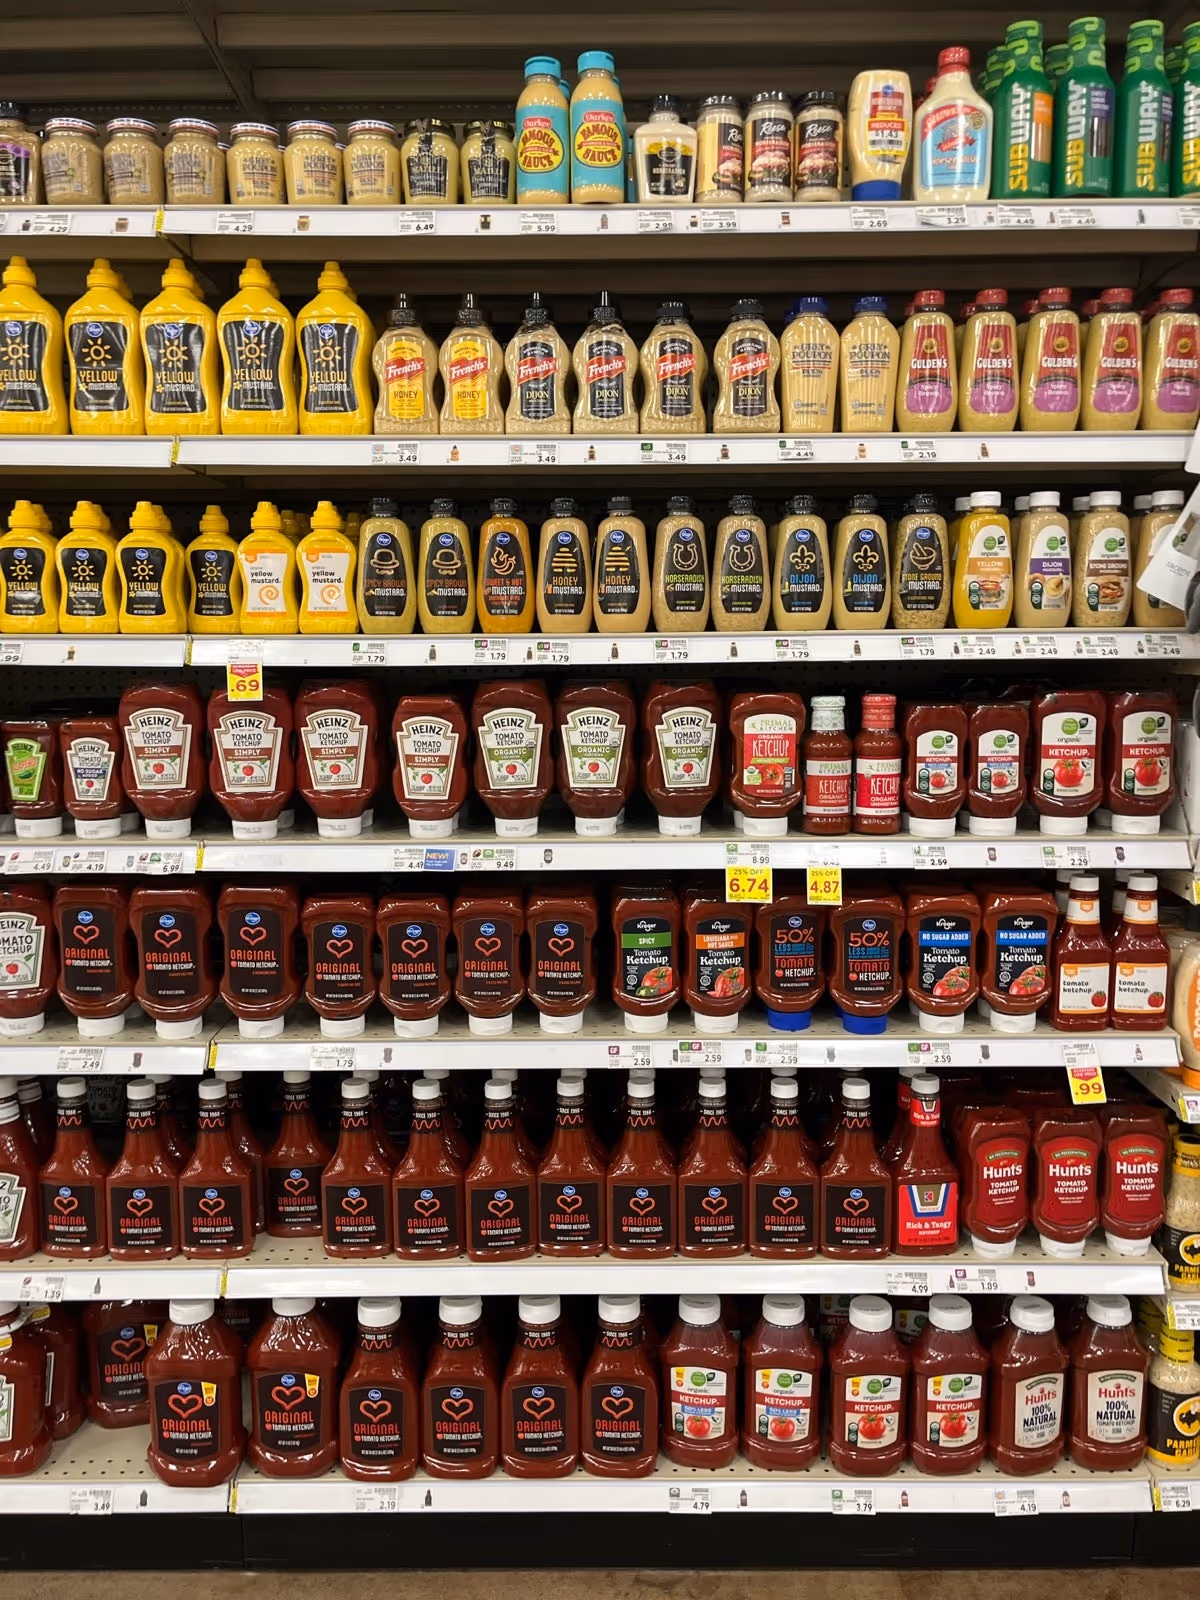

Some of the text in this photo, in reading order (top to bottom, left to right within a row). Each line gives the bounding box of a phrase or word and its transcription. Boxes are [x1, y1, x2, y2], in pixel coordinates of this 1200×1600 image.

[580, 124, 618, 140] FAMOUS
[1009, 81, 1029, 192] SUBWAY
[1065, 79, 1086, 189] SUBWAY
[1136, 81, 1157, 190] SUBWAY
[522, 132, 554, 148] FAMOUS
[583, 148, 617, 162] SAUCE
[523, 154, 553, 168] SAUCE
[946, 216, 966, 224] 3.29
[234, 224, 252, 232] 4.29
[416, 223, 434, 231] 6.49
[537, 224, 555, 232] 5.99
[850, 351, 891, 360] POUPON
[519, 359, 557, 378] French's
[588, 357, 626, 378] French's
[79, 371, 117, 382] YELLOW
[156, 371, 195, 383] YELLOW
[234, 368, 273, 381] YELLOW
[309, 371, 347, 383] YELLOW
[526, 390, 549, 400] DIJON
[595, 389, 619, 399] DIJON
[796, 450, 814, 458] 4.49
[398, 455, 417, 463] 3.49
[537, 455, 556, 463] 3.49
[250, 570, 273, 578] yellow
[312, 570, 335, 578] yellow
[853, 573, 878, 584] DIJON
[553, 576, 578, 585] HONEY
[605, 575, 631, 585] HONEY
[721, 575, 762, 585] HORSERADISH
[790, 574, 815, 584] DIJON
[8, 582, 38, 591] YELLOW
[69, 582, 99, 592] YELLOW
[128, 582, 159, 591] YELLOW
[198, 583, 227, 592] YELLOW
[553, 586, 582, 595] MUSTARD
[605, 585, 635, 594] MUSTARD
[790, 583, 820, 592] MUSTARD
[853, 583, 883, 592] MUSTARD
[908, 581, 940, 591] MUSTARD
[490, 652, 506, 660] 1.79
[671, 651, 688, 659] 1.79
[792, 651, 809, 659] 1.79
[919, 648, 935, 656] 1.79
[1101, 648, 1119, 656] 2.49
[368, 655, 385, 663] 1.79
[552, 654, 569, 662] 1.79
[230, 680, 260, 692] .69
[139, 716, 172, 729] HEINZ
[229, 719, 262, 730] HEINZ
[316, 717, 348, 729] HEINZ
[492, 717, 524, 728] HEINZ
[578, 715, 610, 727] HEINZ
[672, 715, 703, 727] HEINZ
[411, 724, 443, 736] HEINZ
[141, 731, 172, 740] TOMATO
[232, 733, 262, 741] TOMATO
[319, 732, 349, 740] TOMATO
[495, 733, 525, 741] TOMATO
[579, 731, 608, 739] TOMATO
[674, 731, 701, 740] TOMATO
[413, 740, 442, 749] TOMATO
[752, 740, 790, 757] KETCHUP
[234, 748, 262, 756] SIMPLY
[320, 747, 347, 755] SIMPLY
[494, 748, 526, 756] ORGANIC
[577, 746, 610, 754] ORGANIC
[672, 746, 703, 755] ORGANIC
[1049, 747, 1087, 756] KETCHUP
[1130, 747, 1163, 756] KETCHUP
[414, 755, 440, 763] SIMPLY
[426, 852, 449, 860] NEW!
[752, 856, 770, 864] 8.99
[496, 860, 514, 869] 9.49
[930, 858, 947, 866] 2.59
[1071, 858, 1088, 866] 2.29
[33, 863, 52, 871] 4.49
[86, 863, 104, 871] 4.19
[163, 865, 180, 873] 6.99
[733, 868, 764, 876] 25% OFF
[729, 878, 769, 894] 6.74
[810, 881, 840, 893] 4.87
[711, 921, 731, 931] Kroger
[849, 932, 889, 947] 50%
[922, 932, 969, 941] NO SUGAR ADDED
[999, 931, 1045, 940] NO SUGAR ADDED
[638, 937, 655, 945] SPICY
[65, 947, 110, 959] ORIGINAL
[635, 949, 661, 957] Tomato
[708, 949, 734, 957] Tomato
[931, 947, 958, 955] Tomato
[1008, 946, 1036, 954] Tomato
[145, 951, 192, 963] ORIGINAL
[230, 949, 276, 961] ORIGINAL
[924, 953, 966, 964] Ketchup
[1000, 952, 1043, 964] Ketchup
[627, 954, 668, 966] Ketchup
[700, 955, 741, 966] Ketchup
[316, 963, 361, 973] ORIGINAL
[391, 962, 435, 973] ORIGINAL
[464, 960, 508, 972] ORIGINAL
[538, 960, 581, 972] ORIGINAL
[849, 961, 890, 972] TOMATO
[859, 971, 889, 980] KETCHUP
[633, 1057, 651, 1066] 2.59
[704, 1054, 721, 1063] 2.59
[780, 1056, 798, 1064] 2.59
[934, 1055, 951, 1063] 2.59
[82, 1061, 99, 1069] 2.49
[336, 1060, 353, 1068] 1.79
[1075, 1083, 1103, 1095] .99
[983, 1163, 1022, 1179] Hunt's
[1049, 1164, 1091, 1179] Hunt's
[1116, 1161, 1159, 1176] Hunt's
[911, 1285, 929, 1293] 4.99
[44, 1290, 60, 1298] 1.39
[679, 1396, 717, 1405] KETCHUP
[764, 1397, 802, 1406] KETCHUP
[1025, 1389, 1057, 1405] Hunt's
[854, 1403, 892, 1412] KETCHUP
[936, 1401, 973, 1411] KETCHUP
[1032, 1403, 1051, 1417] 100%
[1106, 1401, 1128, 1411] 100%
[265, 1410, 313, 1423] ORIGINAL
[1023, 1412, 1057, 1427] NATURAL
[1096, 1410, 1136, 1421] NATURAL
[162, 1418, 211, 1431] ORIGINAL
[353, 1423, 399, 1435] ORIGINAL
[436, 1420, 481, 1433] ORIGINAL
[517, 1420, 563, 1432] ORIGINAL
[595, 1419, 641, 1432] ORIGINAL
[94, 1502, 110, 1511] 3.49
[379, 1501, 396, 1509] 2.19
[693, 1502, 710, 1510] 4.79
[855, 1503, 872, 1512] 3.79
[1020, 1503, 1036, 1512] 4.19
[1175, 1500, 1191, 1508] 6.29
